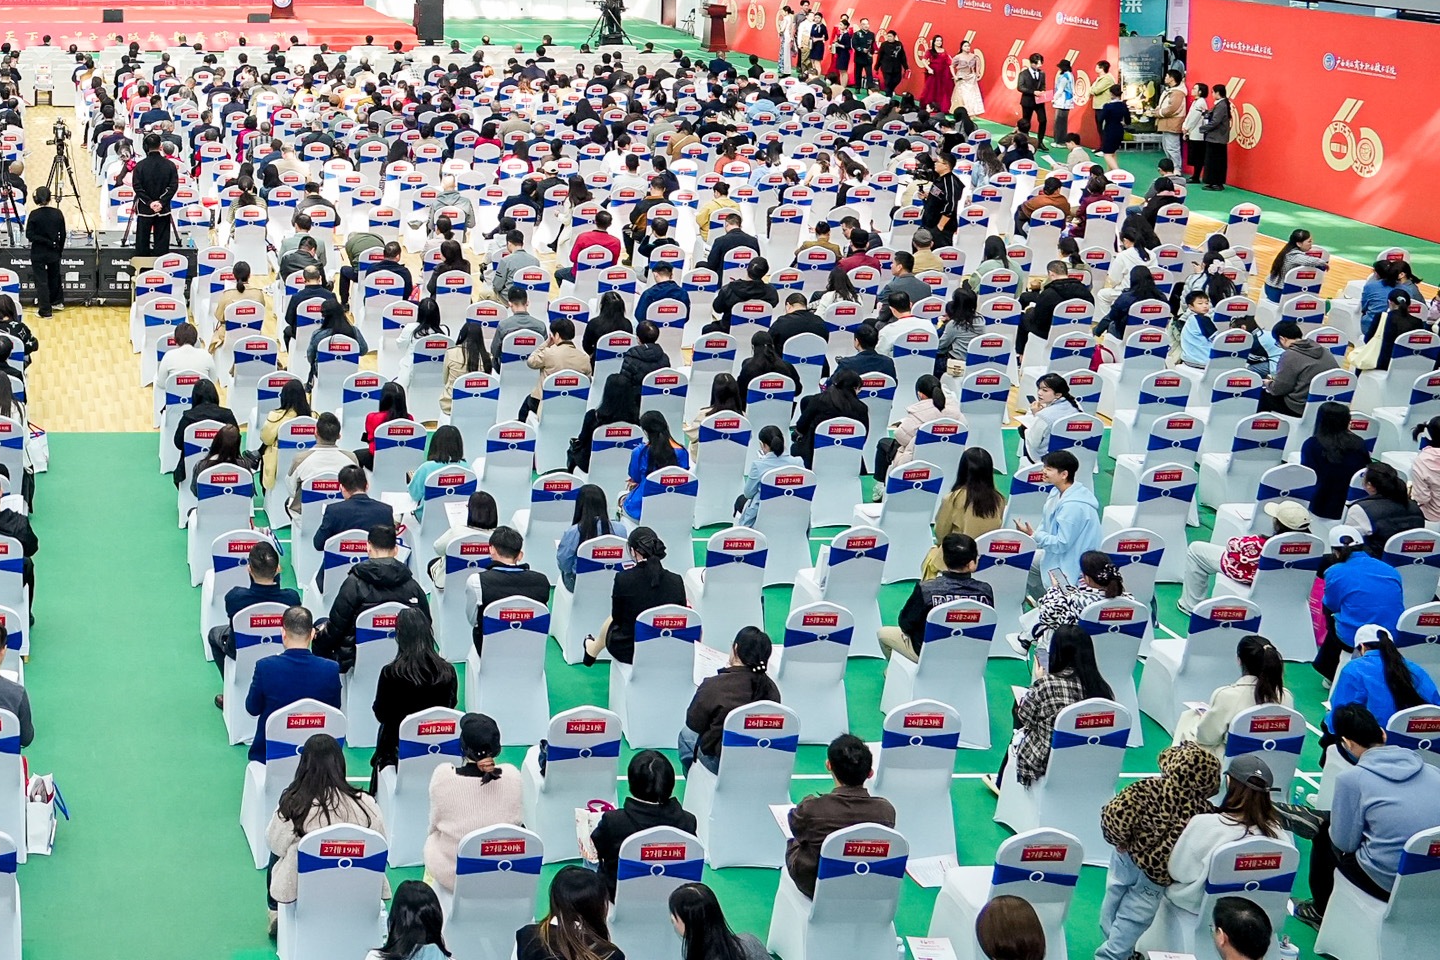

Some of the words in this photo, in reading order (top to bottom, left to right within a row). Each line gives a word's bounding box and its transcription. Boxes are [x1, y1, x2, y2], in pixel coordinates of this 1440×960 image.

[656, 619, 684, 627] 25排22座
[747, 719, 781, 727] 26排22座
[907, 718, 941, 727] 26排23座
[422, 726, 453, 736] 26排20座
[570, 724, 602, 732] 26排21座
[325, 846, 360, 855] 27排19座
[485, 844, 521, 853] 27排20座
[849, 846, 885, 854] 27排22座
[644, 849, 682, 858] 27排21座
[1238, 859, 1277, 869] 27排24座
